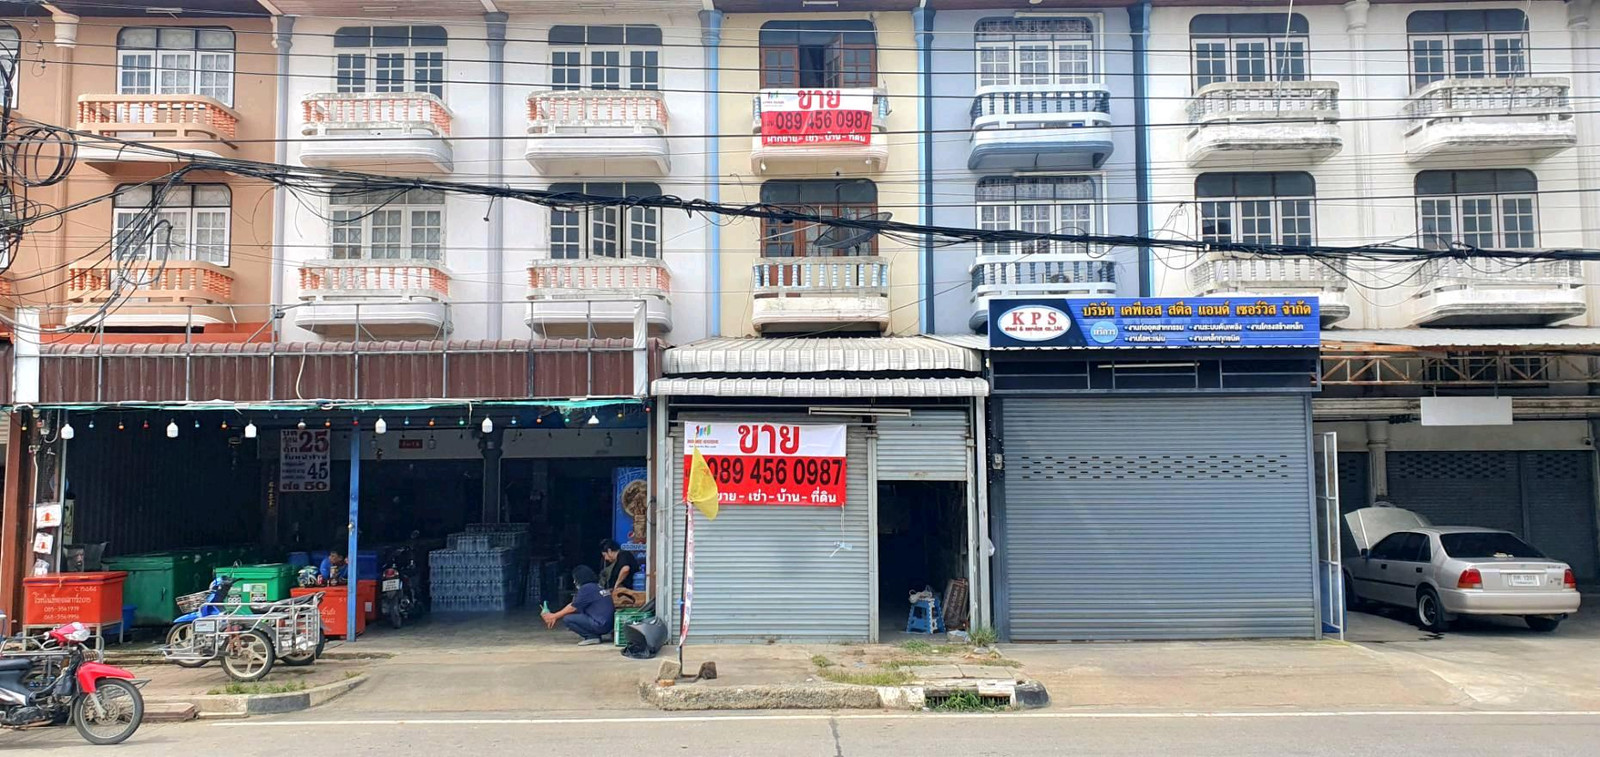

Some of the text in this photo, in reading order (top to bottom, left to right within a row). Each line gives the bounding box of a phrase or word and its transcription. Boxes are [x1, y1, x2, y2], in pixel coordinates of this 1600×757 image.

[797, 90, 841, 110] ขาย
[776, 112, 802, 130] 089
[807, 111, 832, 130] 456
[836, 111, 872, 130] 0987
[1082, 300, 1311, 317] บริษัท เคพีเอส สตีล แอนด์ เซอร์วิส จำกัด
[299, 430, 329, 453] 25
[737, 423, 800, 456] ขาย
[307, 462, 328, 479] 45
[706, 456, 843, 486] 089 456 0987
[304, 481, 328, 490] 50
[748, 488, 768, 504] เช่า
[776, 488, 800, 504] บ้าน
[810, 485, 837, 504] ที่ดิน
